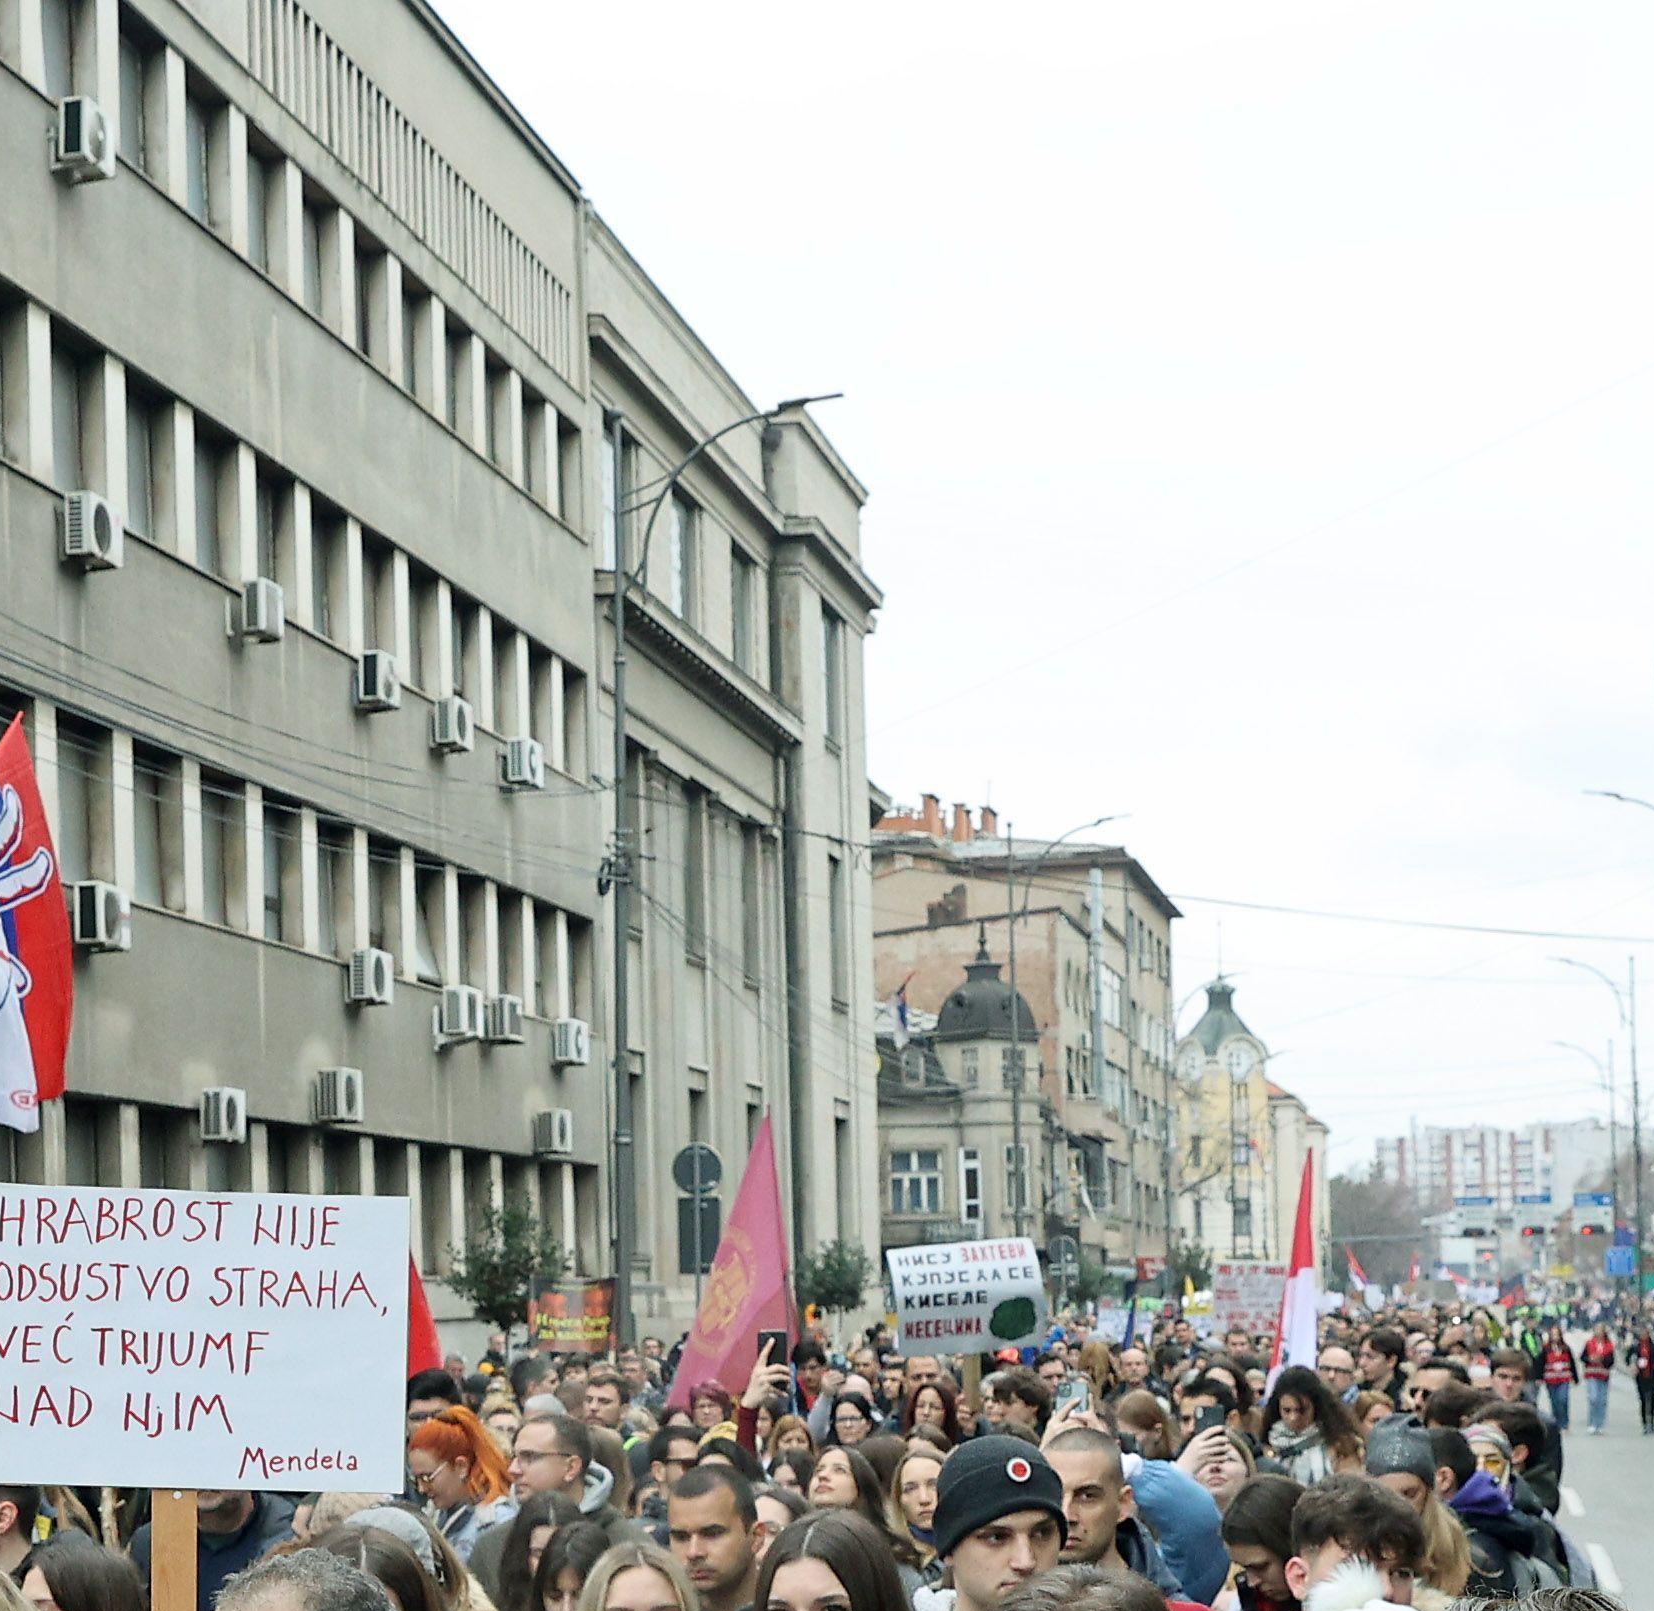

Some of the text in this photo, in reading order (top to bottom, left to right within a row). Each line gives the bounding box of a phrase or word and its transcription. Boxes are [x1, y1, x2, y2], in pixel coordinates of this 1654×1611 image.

[253, 1203, 341, 1251] NIJE
[897, 1243, 1028, 1267] НИСУ ЗАХТЕВИ
[208, 1266, 389, 1317] STRAHA,
[901, 1267, 971, 1288] КУПУС
[904, 1289, 989, 1310] КИСЕЛЕ
[90, 1326, 271, 1376] TRIJUMF
[237, 1446, 359, 1480] Mendela
